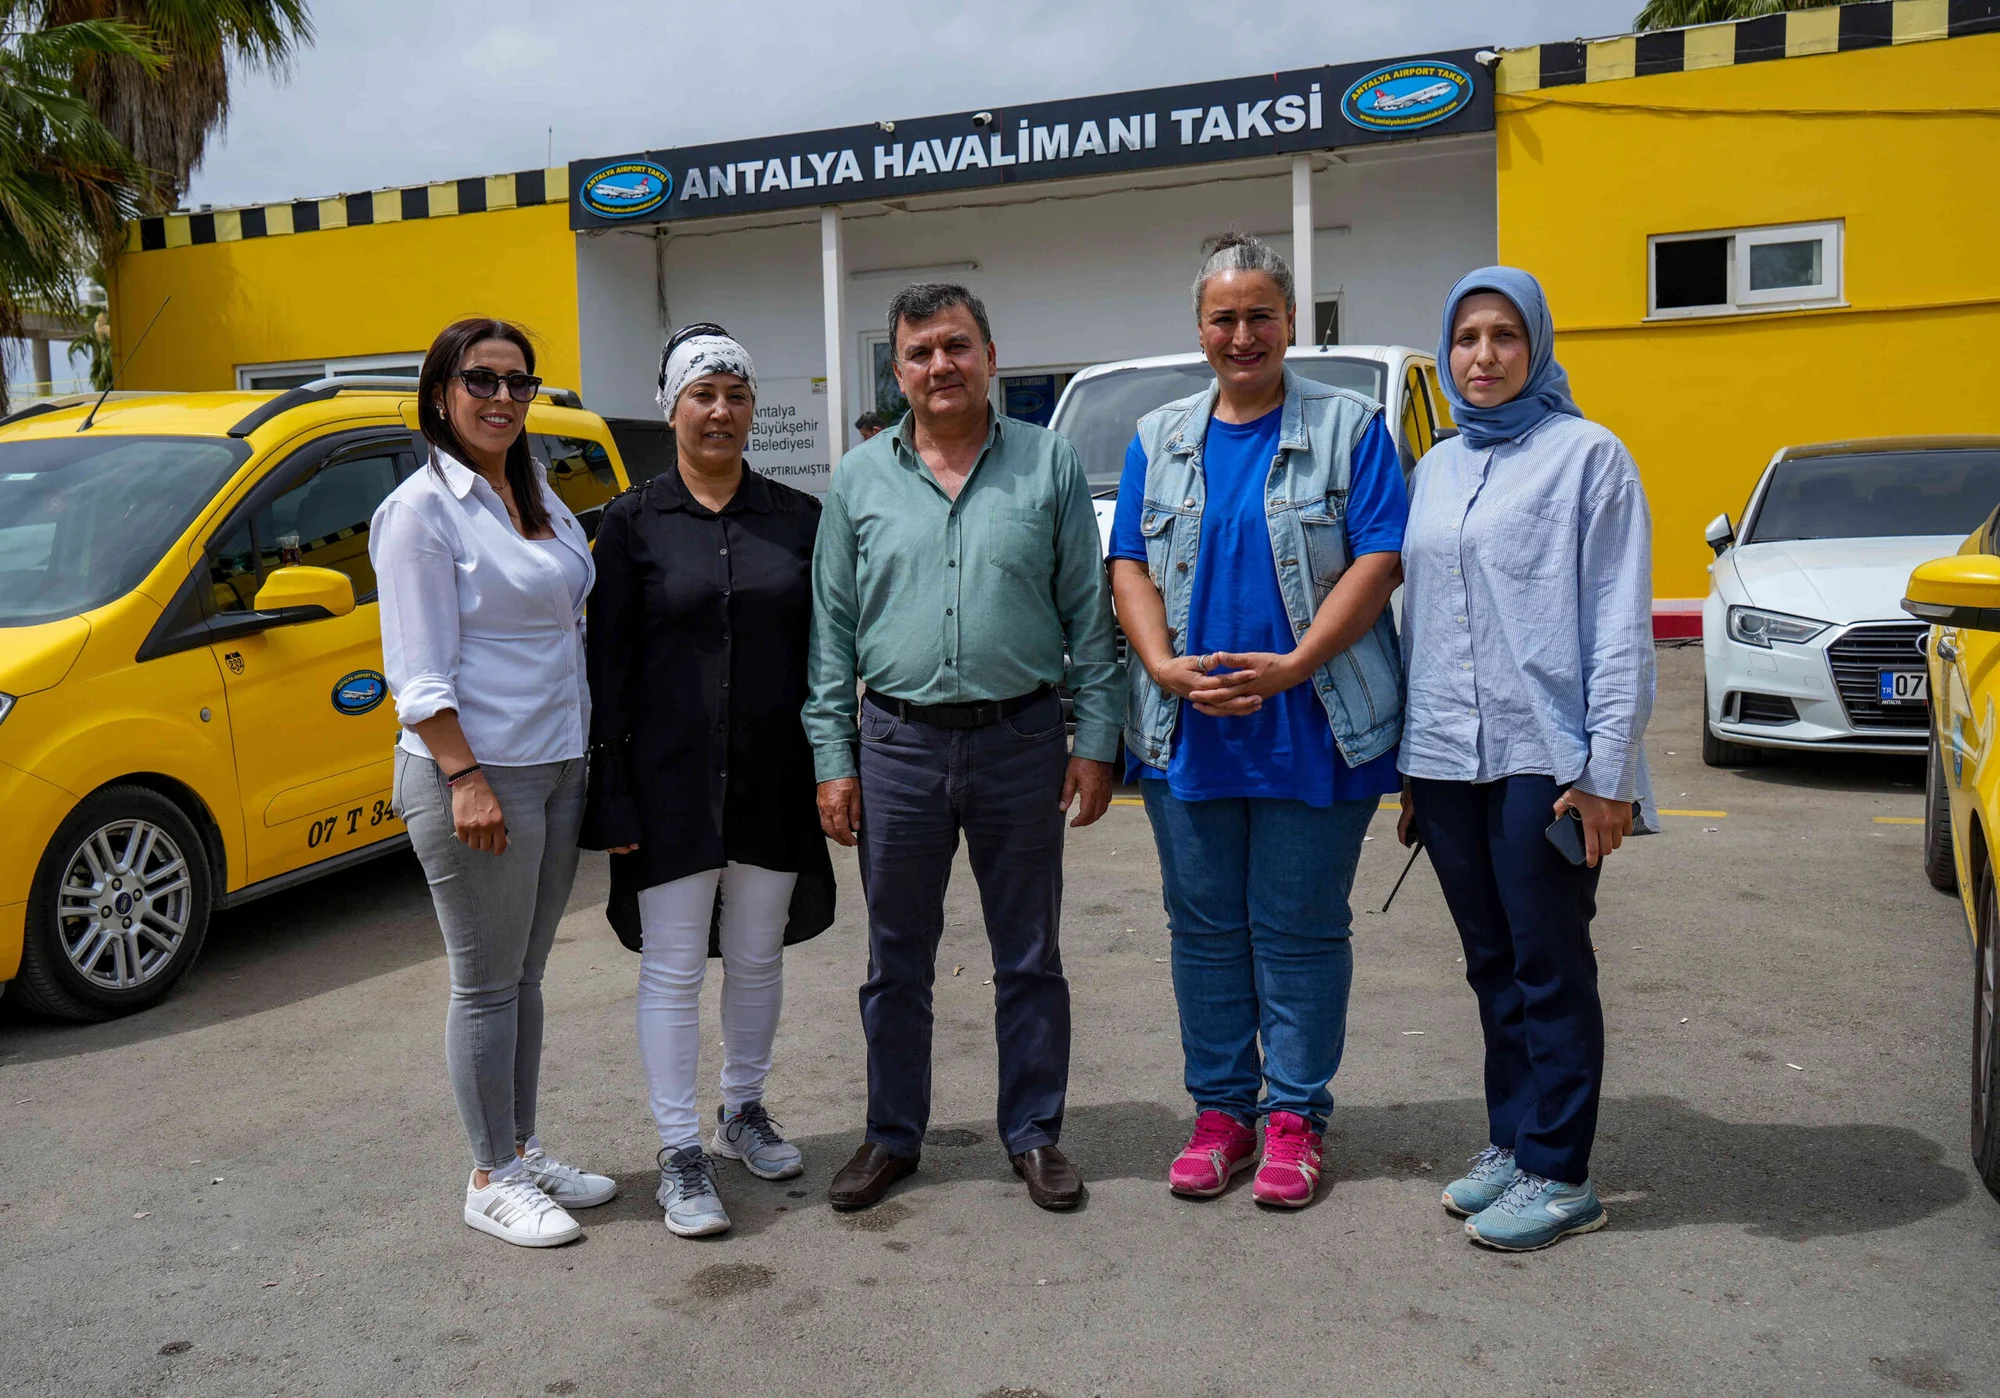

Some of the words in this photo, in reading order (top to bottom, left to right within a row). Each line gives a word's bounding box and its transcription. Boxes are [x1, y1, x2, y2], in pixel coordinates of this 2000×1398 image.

[1351, 74, 1391, 101] ANTALYA
[1393, 67, 1435, 79] AIRPORT
[680, 149, 863, 201] ANTALYA
[874, 112, 1156, 180] HAVALİMANI
[1170, 83, 1323, 145] TAKSİ
[586, 169, 615, 190] ANTALYA
[616, 165, 646, 174] AIRPORT
[752, 419, 819, 437] Büyükşehir
[752, 436, 815, 453] Belediyesi
[1895, 674, 1924, 697] 07
[308, 815, 338, 848] 07
[346, 806, 363, 835] T
[370, 799, 397, 827] 34
